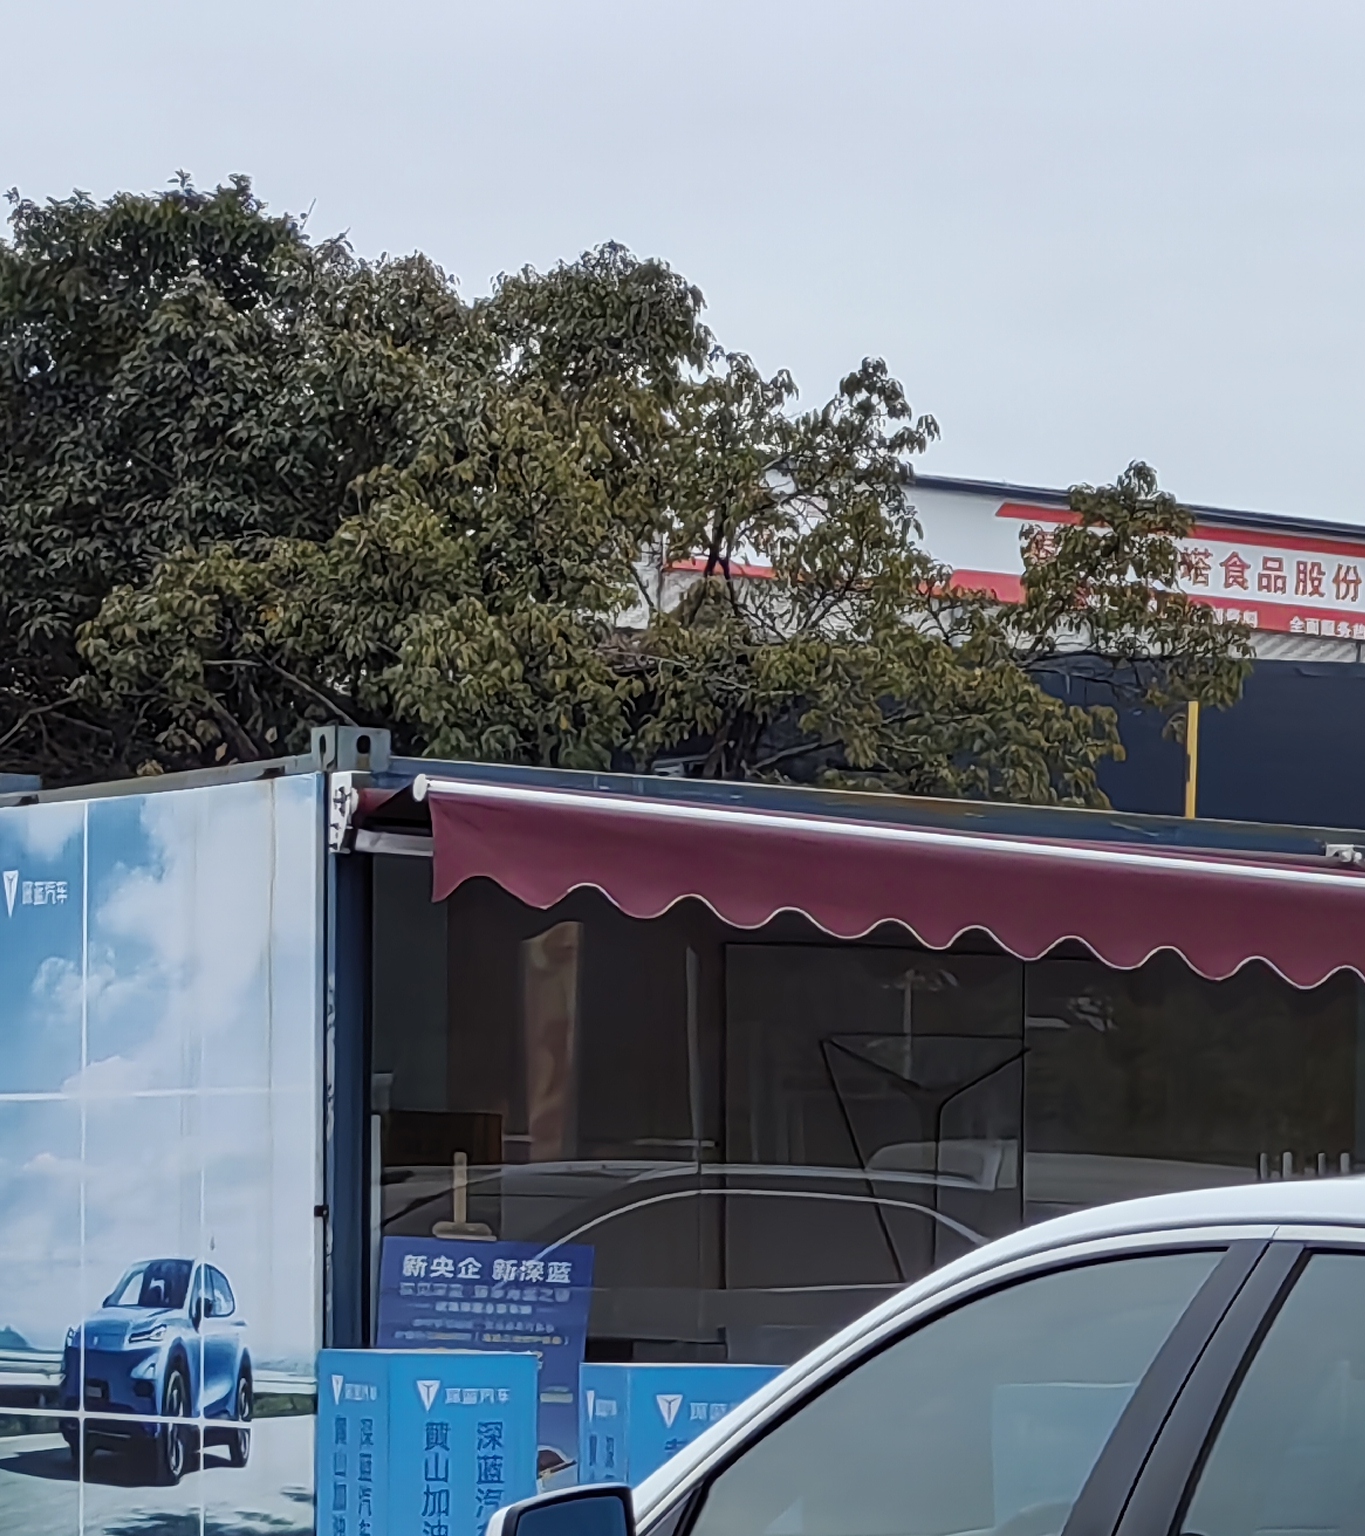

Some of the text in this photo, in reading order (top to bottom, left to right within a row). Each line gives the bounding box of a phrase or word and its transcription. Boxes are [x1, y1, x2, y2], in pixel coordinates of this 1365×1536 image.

[402, 1254, 573, 1284] 新央企 新深蓝
